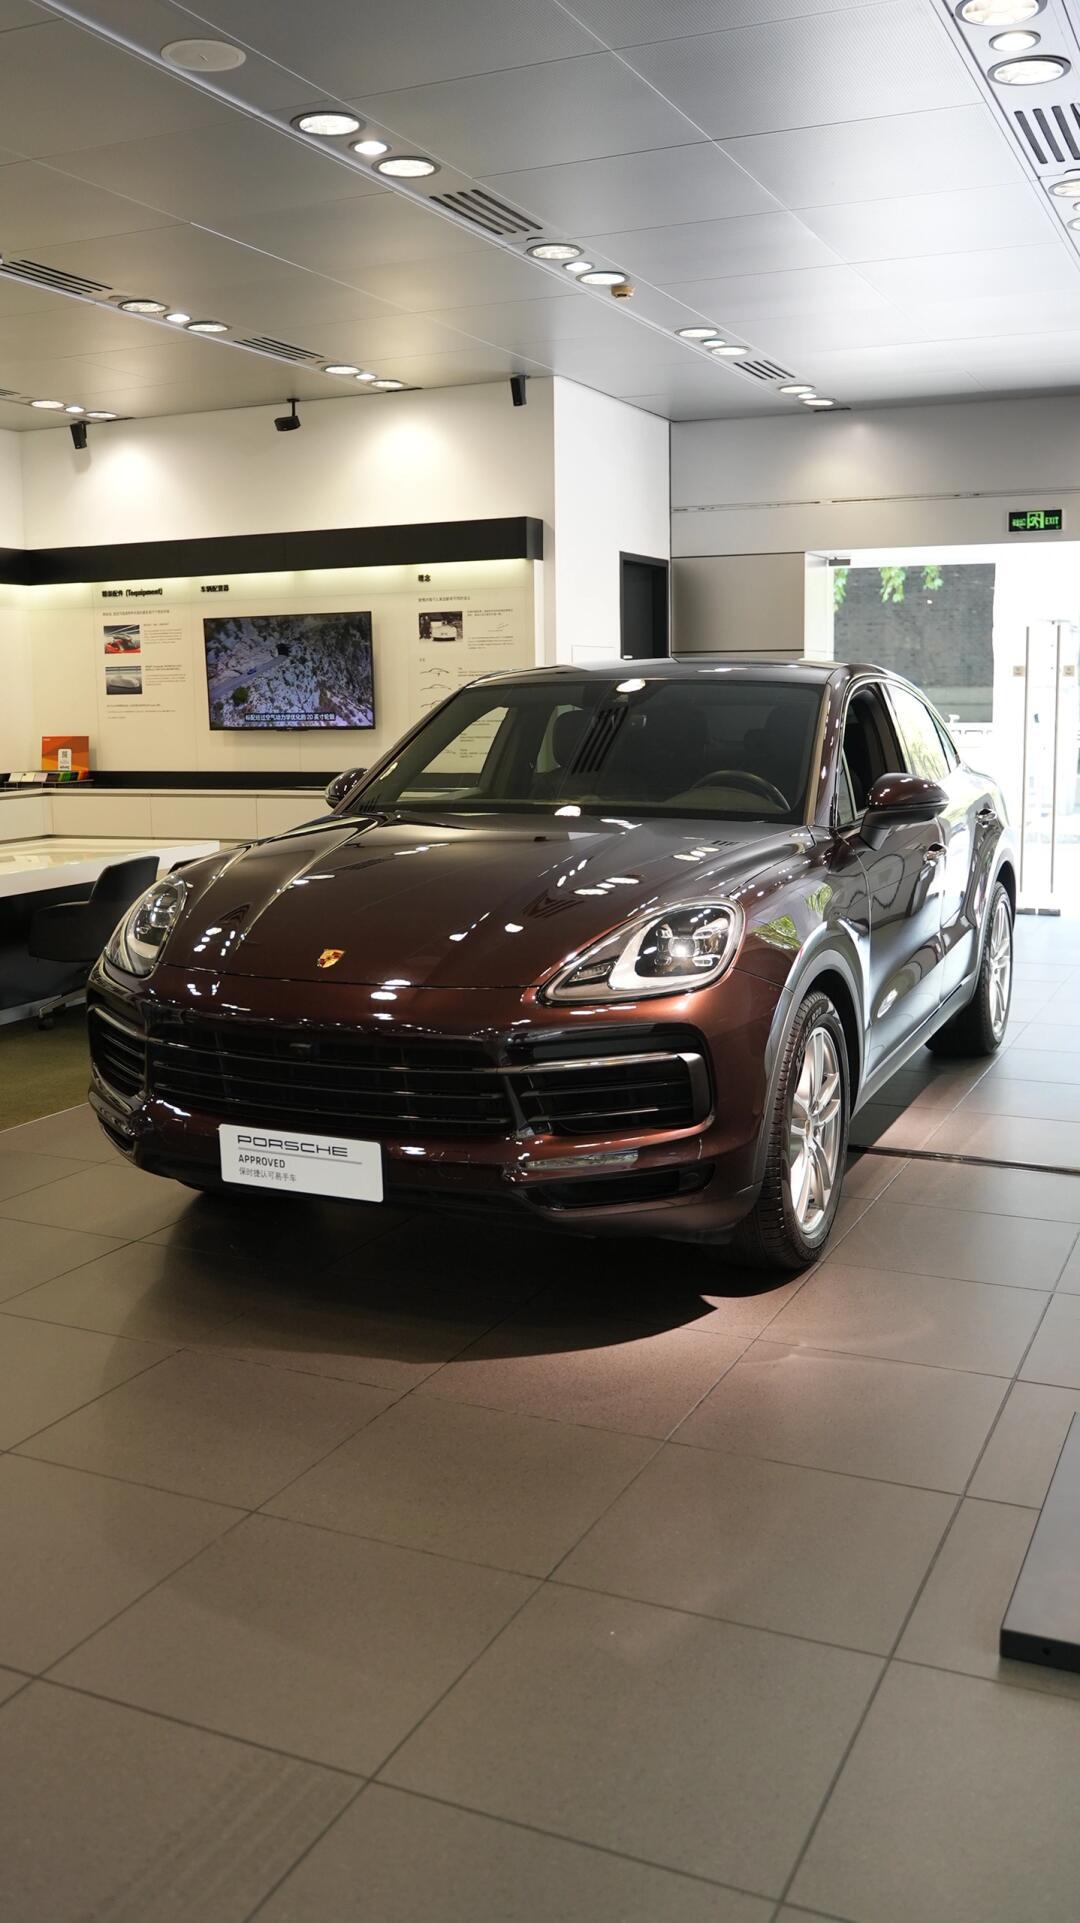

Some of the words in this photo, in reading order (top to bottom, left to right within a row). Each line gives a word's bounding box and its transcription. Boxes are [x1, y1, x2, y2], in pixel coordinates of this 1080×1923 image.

[1045, 516, 1059, 525] EXIT
[237, 1135, 348, 1157] PORSCHE
[238, 1154, 286, 1169] APPROVED
[239, 1167, 296, 1182] 保时捷认可易手车
